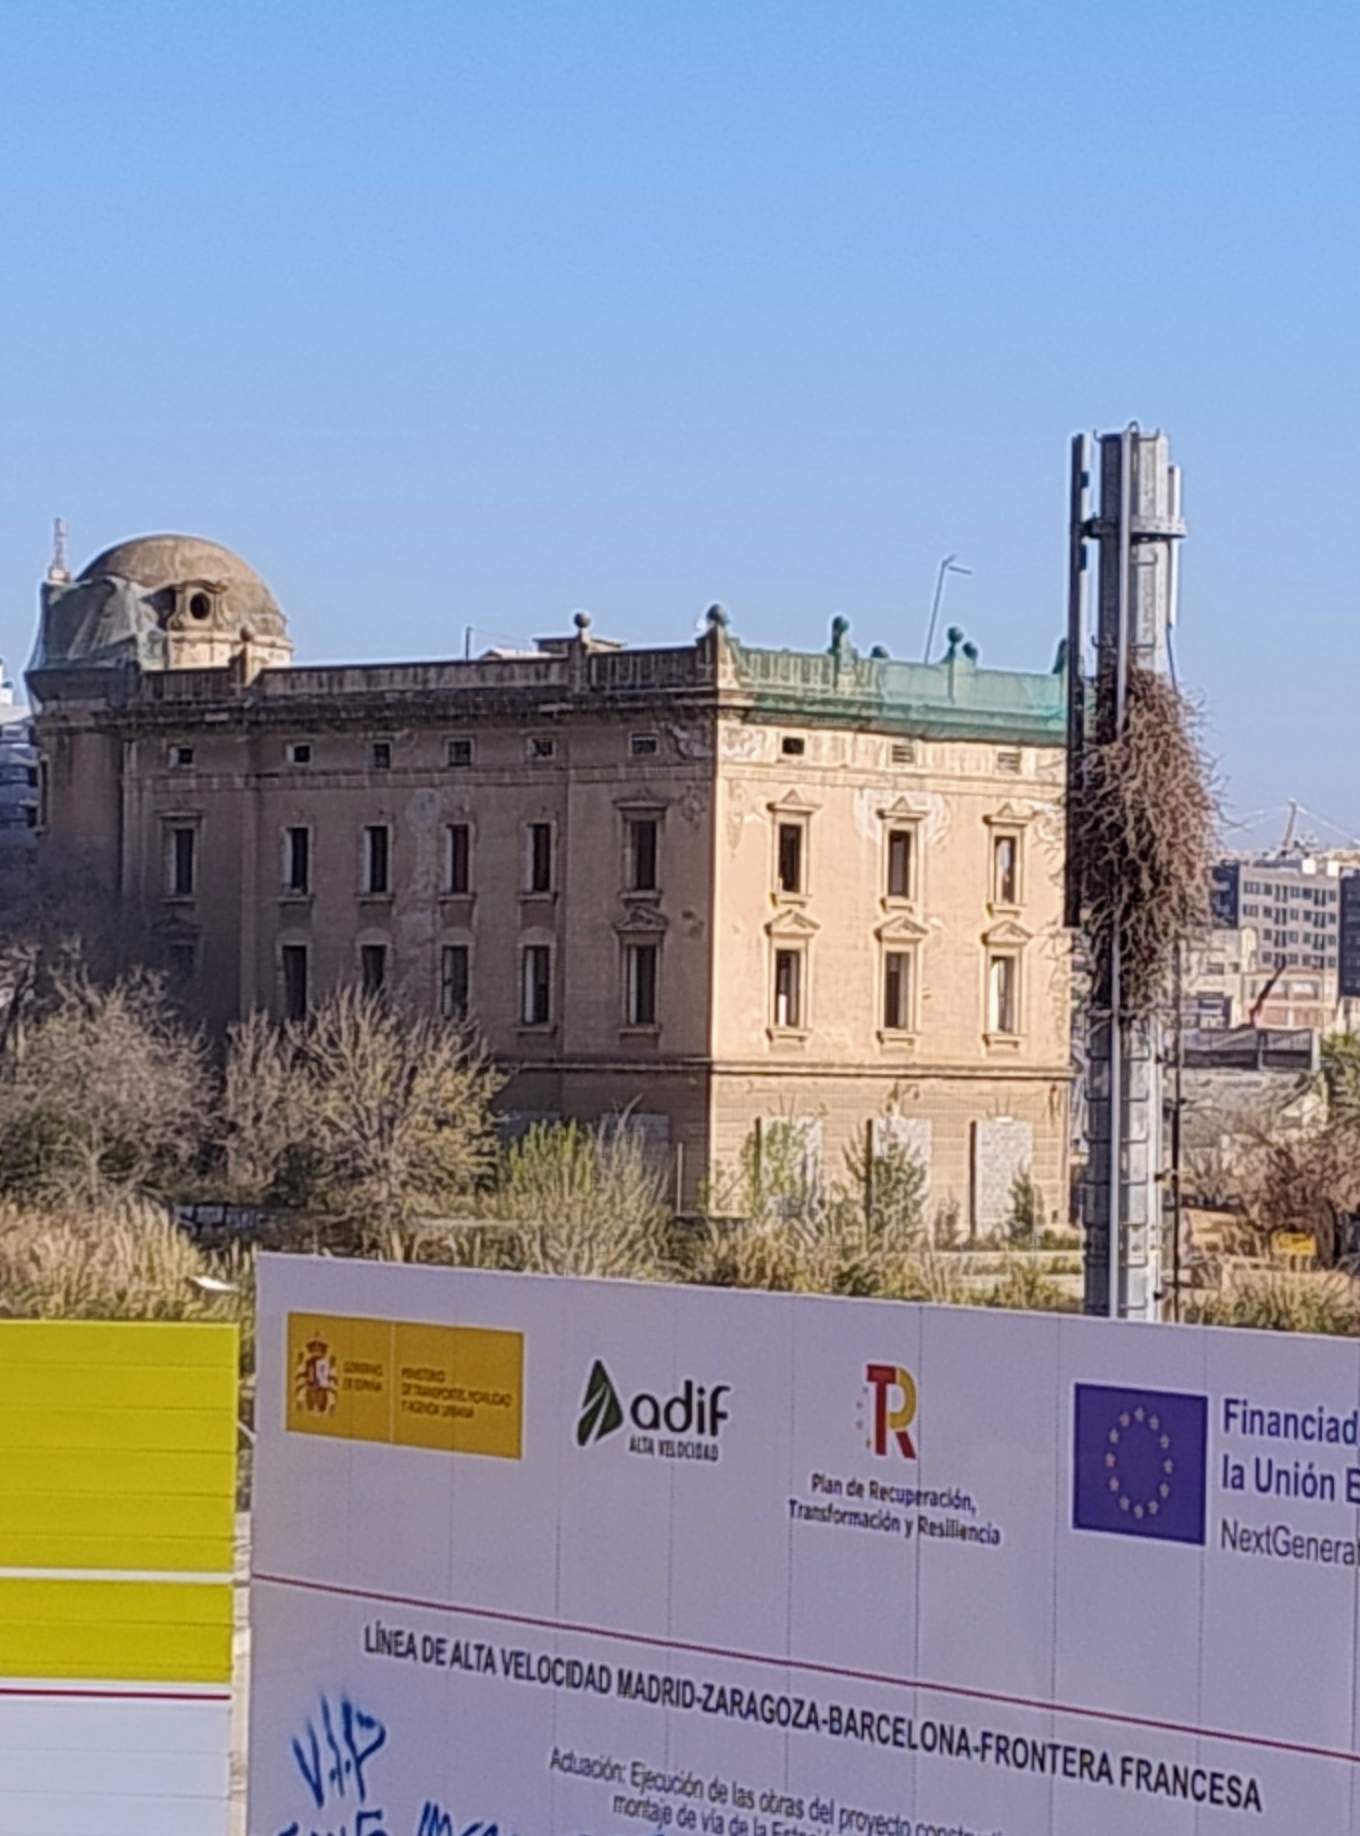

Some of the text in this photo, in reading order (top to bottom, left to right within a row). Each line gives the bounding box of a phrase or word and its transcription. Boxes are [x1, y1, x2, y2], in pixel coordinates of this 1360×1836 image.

[630, 1379, 731, 1437] adif
[629, 1436, 719, 1462] ALTA VELOCIDAD
[810, 1472, 977, 1517] Plan de Recuperación,
[1222, 1453, 1245, 1491] la
[1254, 1456, 1335, 1502] Unión
[788, 1499, 1002, 1546] Transformación y Resiliencia
[364, 1620, 1263, 1813] LÍNEA DE ALTA VELOCIDAD MADRID-ZARAGOZA-BARCELONA-FRONTERA FRANCESA
[630, 1760, 704, 1799] Ejecución
[708, 1776, 729, 1806] de
[732, 1780, 756, 1810] las
[758, 1788, 806, 1821] obras
[808, 1794, 836, 1826] del
[675, 1803, 697, 1830] de
